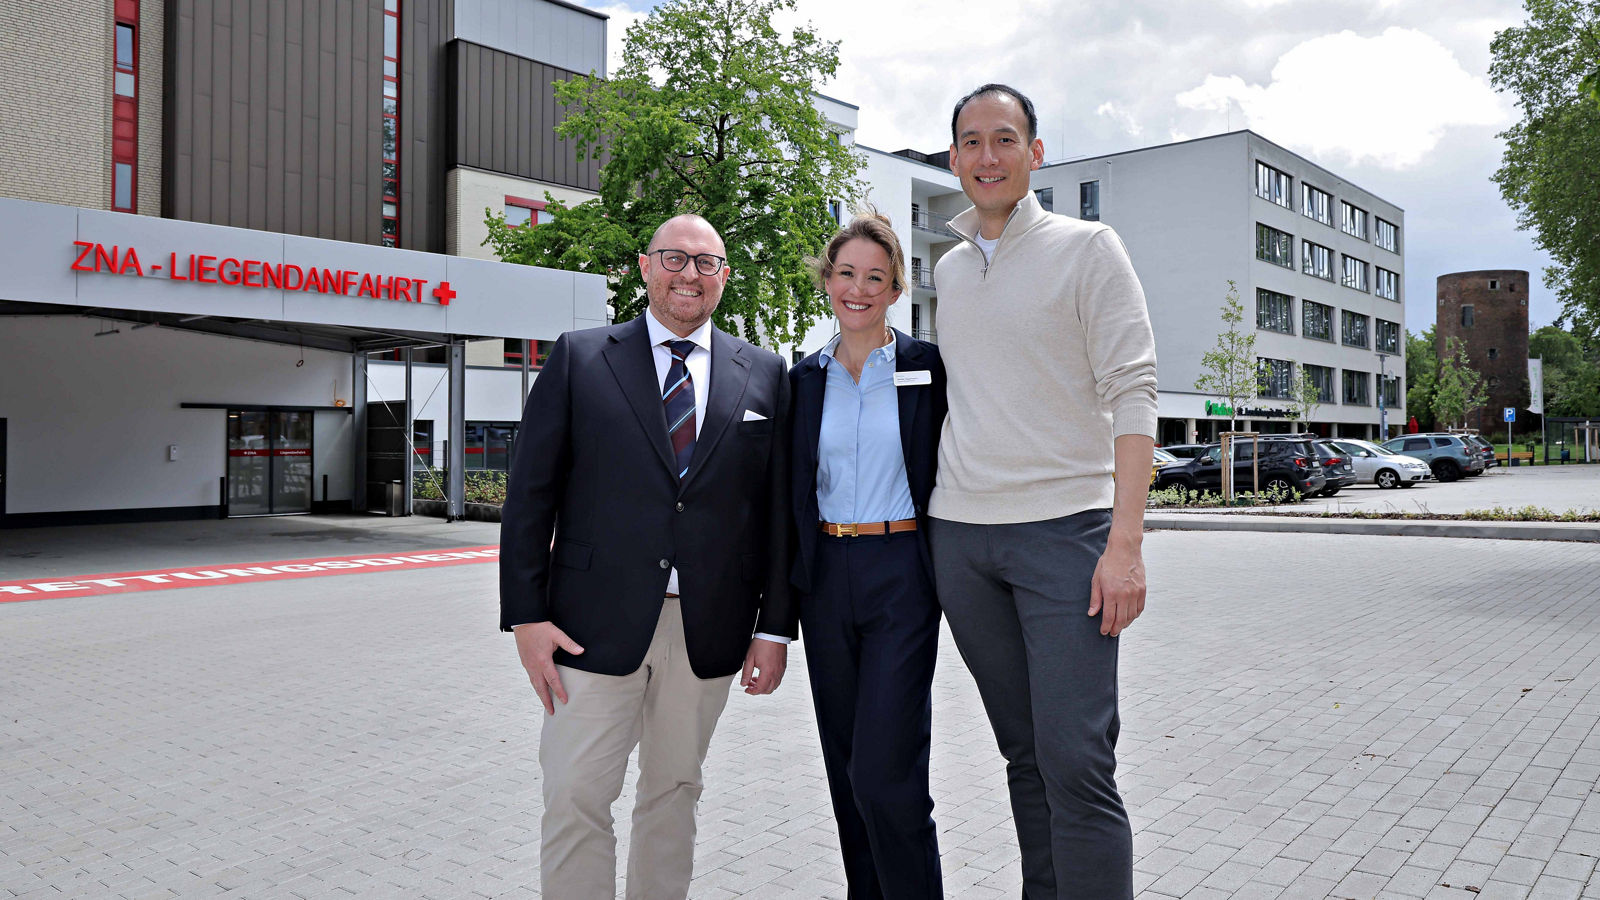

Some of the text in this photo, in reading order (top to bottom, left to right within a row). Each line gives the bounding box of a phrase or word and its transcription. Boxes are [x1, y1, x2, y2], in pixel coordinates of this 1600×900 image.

[70, 240, 144, 277] ZNA
[170, 251, 428, 304] LIEGENDANFAHRT
[1506, 408, 1514, 418] P
